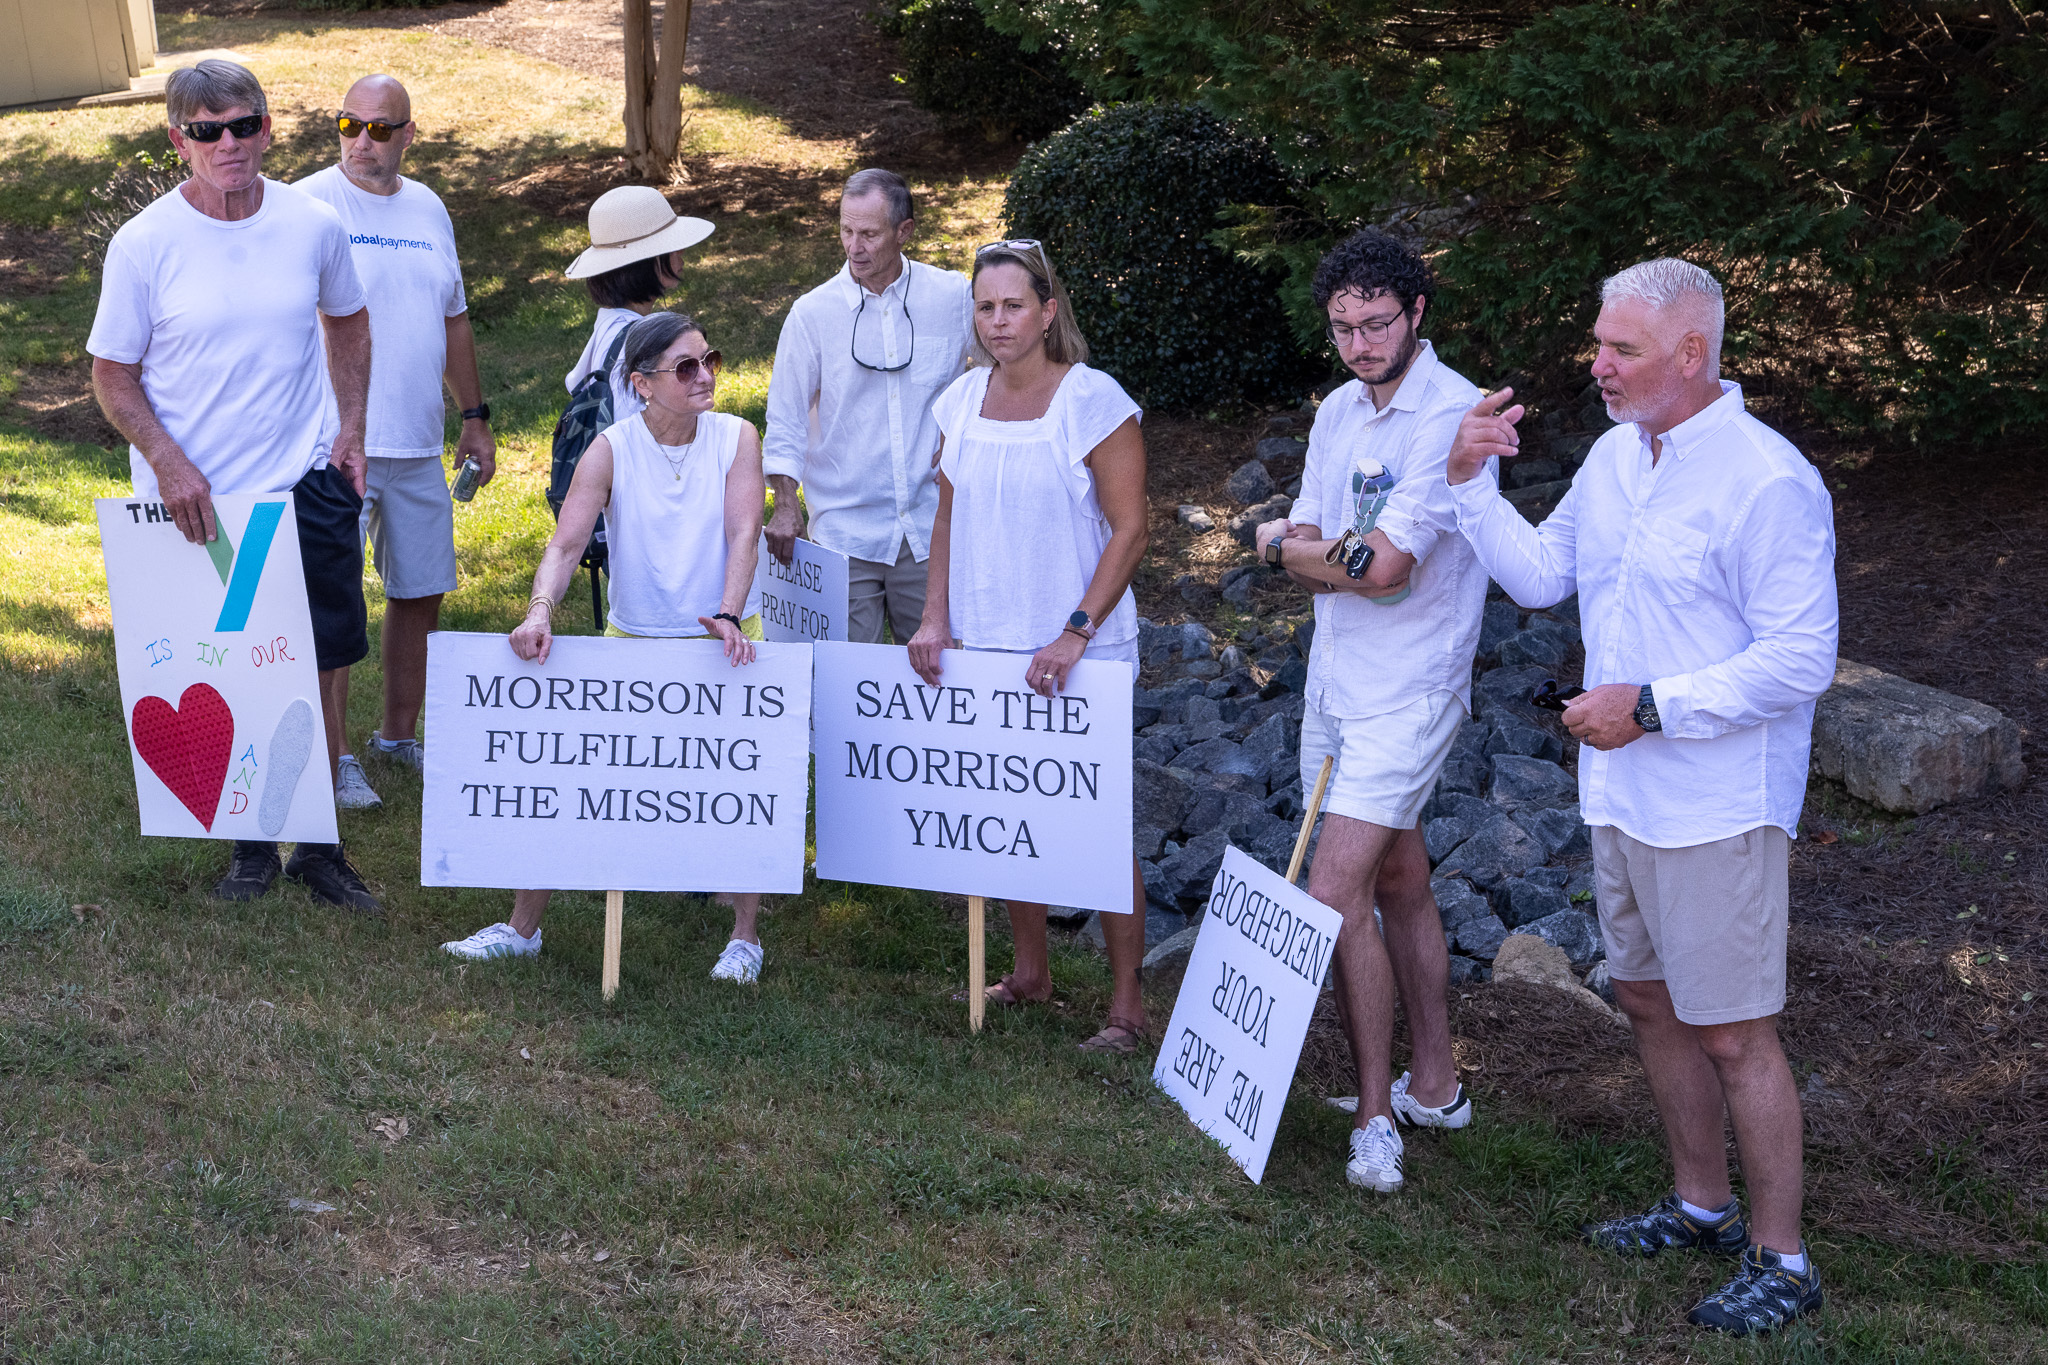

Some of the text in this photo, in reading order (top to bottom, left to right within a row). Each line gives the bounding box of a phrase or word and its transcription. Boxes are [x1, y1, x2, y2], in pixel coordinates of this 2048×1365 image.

[349, 234, 433, 251] lobalpayments
[126, 503, 173, 524] THE
[768, 553, 822, 593] PLEASE
[761, 591, 830, 641] PRAY FOR
[145, 636, 295, 667] IS IN OUR
[464, 674, 785, 718] MORRISON IS
[856, 680, 977, 726] SAVE
[991, 689, 1091, 736] THE
[484, 730, 762, 772] FULFILLING
[845, 741, 1101, 801] MORRISON
[461, 783, 778, 826] THE MISSION
[904, 808, 1040, 859] YMCA
[1211, 869, 1332, 987] NEIGHBOR
[1212, 961, 1276, 1049] YOUR
[1173, 1026, 1265, 1142] WE ARE
